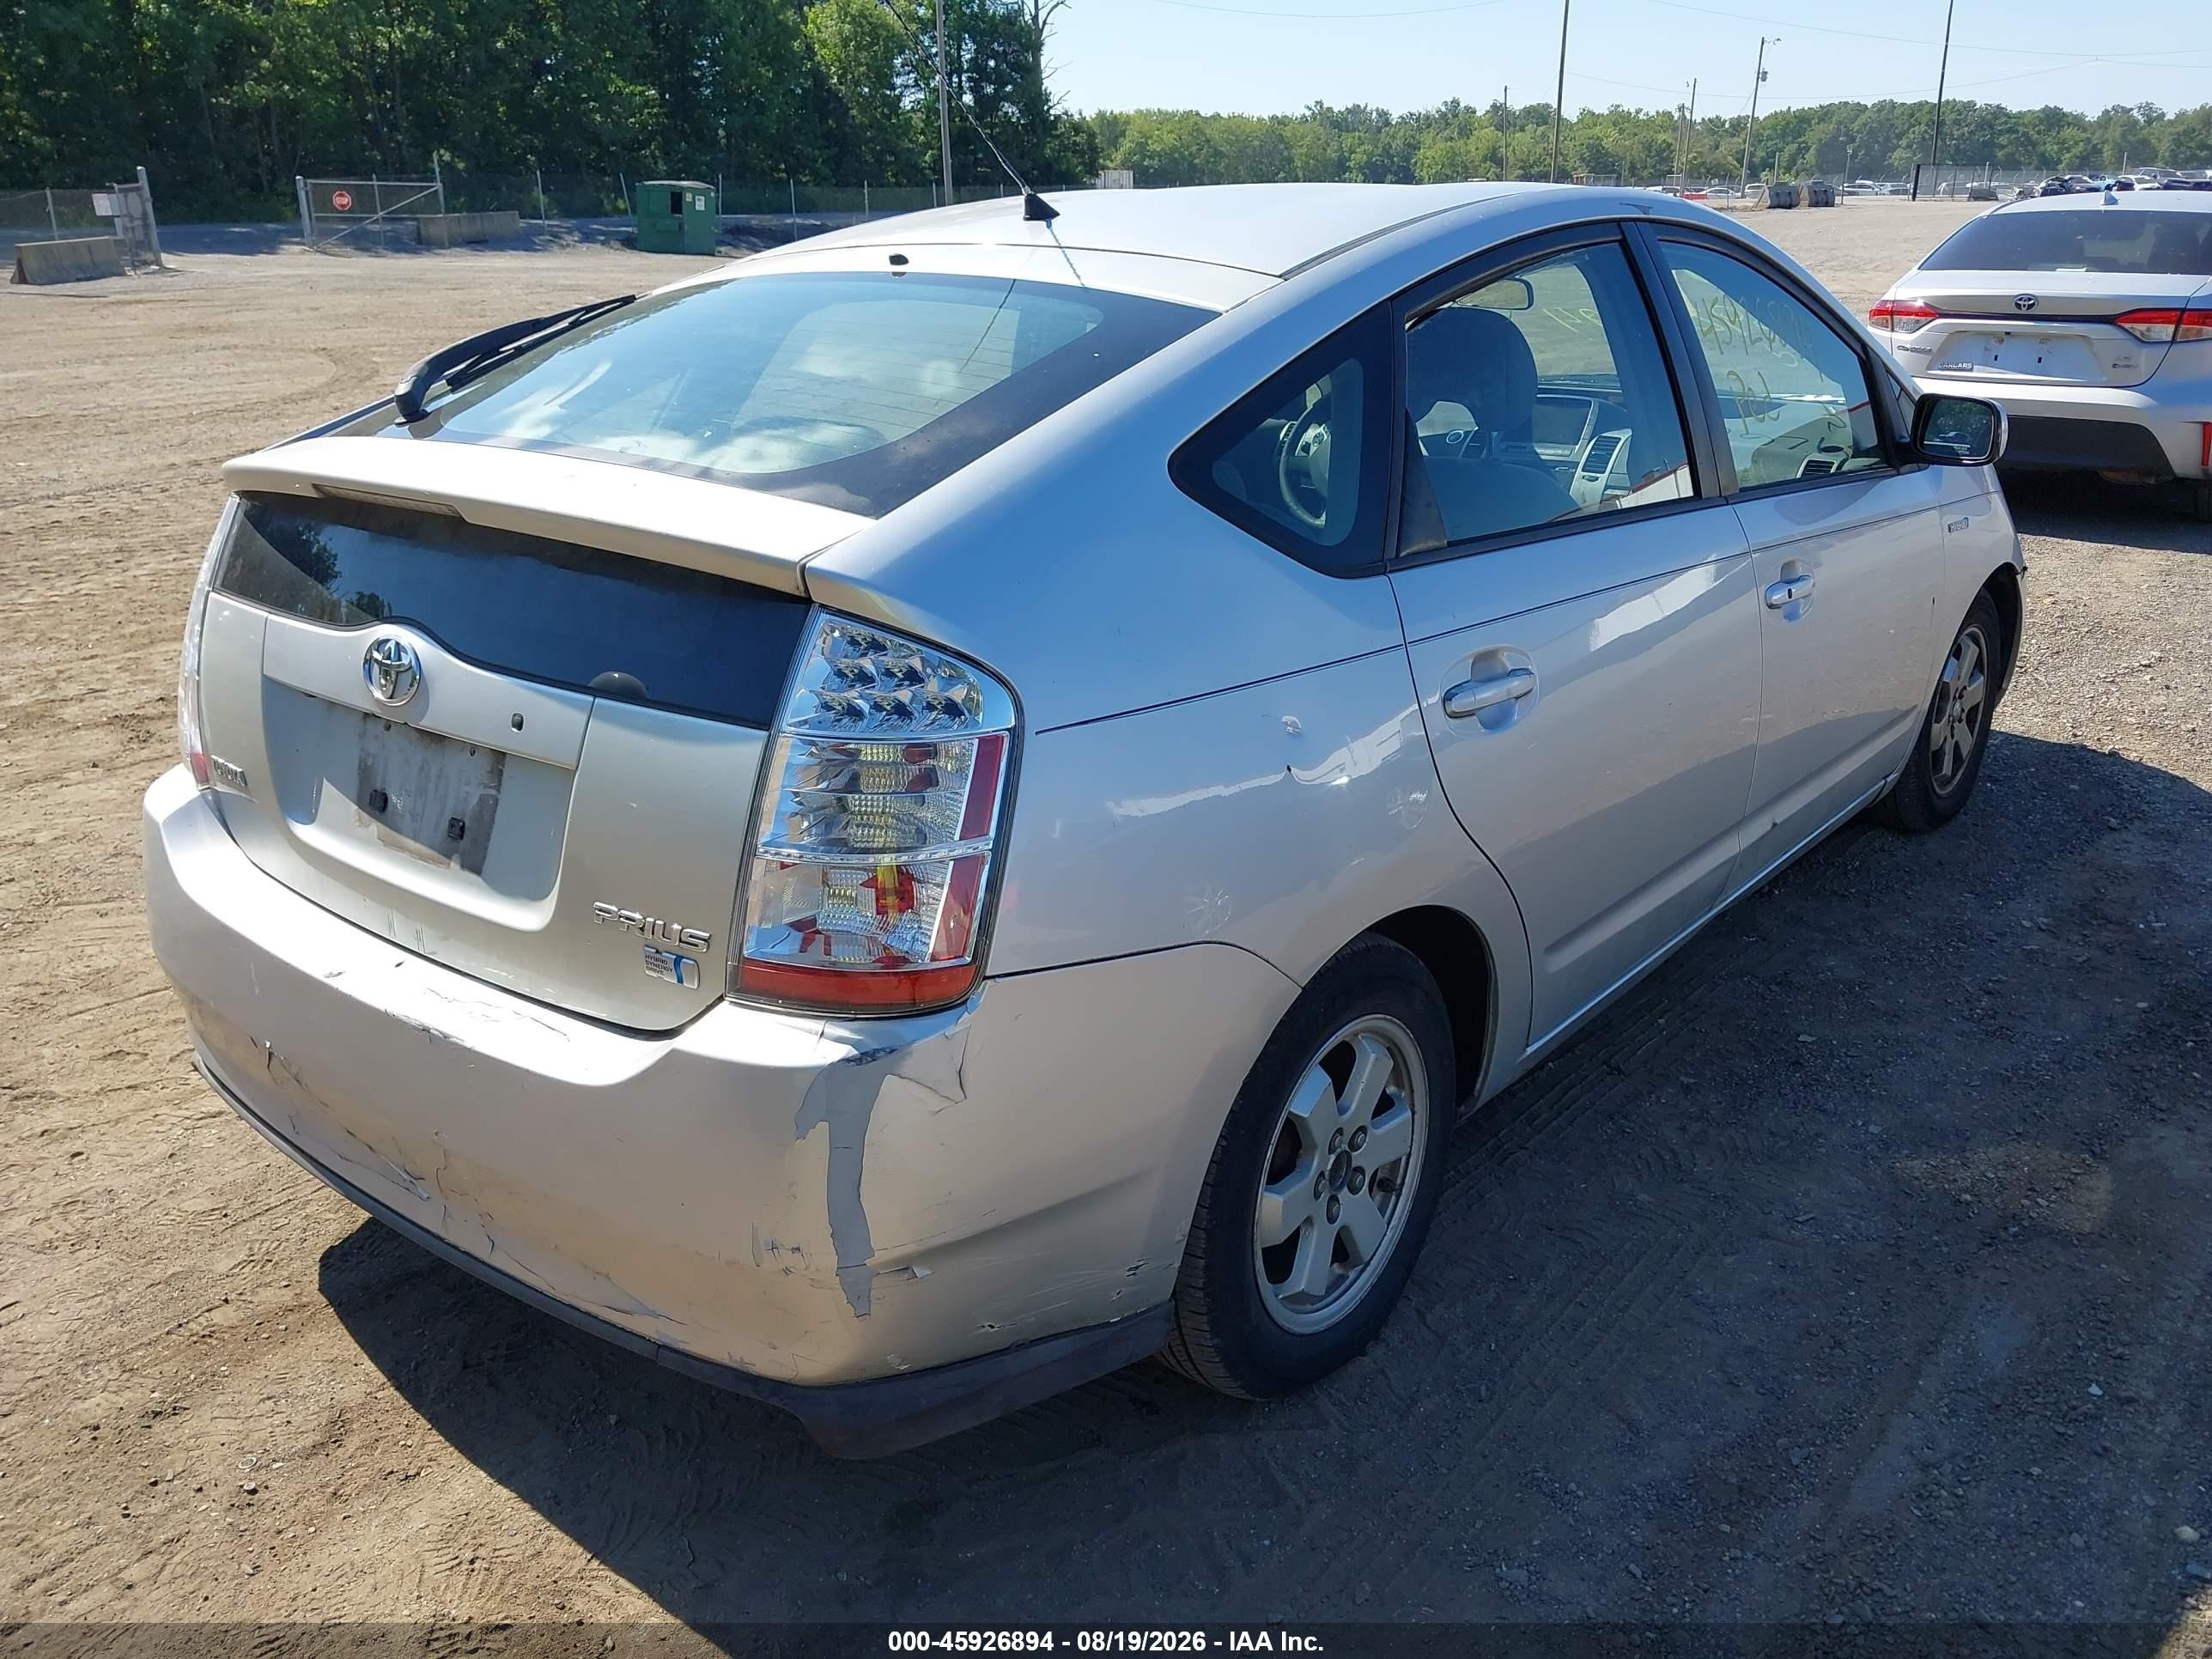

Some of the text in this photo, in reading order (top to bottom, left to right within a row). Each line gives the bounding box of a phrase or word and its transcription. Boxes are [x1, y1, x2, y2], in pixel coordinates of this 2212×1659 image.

[592, 901, 712, 952] PRIUS
[645, 954, 668, 966] HYBRID
[645, 959, 673, 973] SYNERGY
